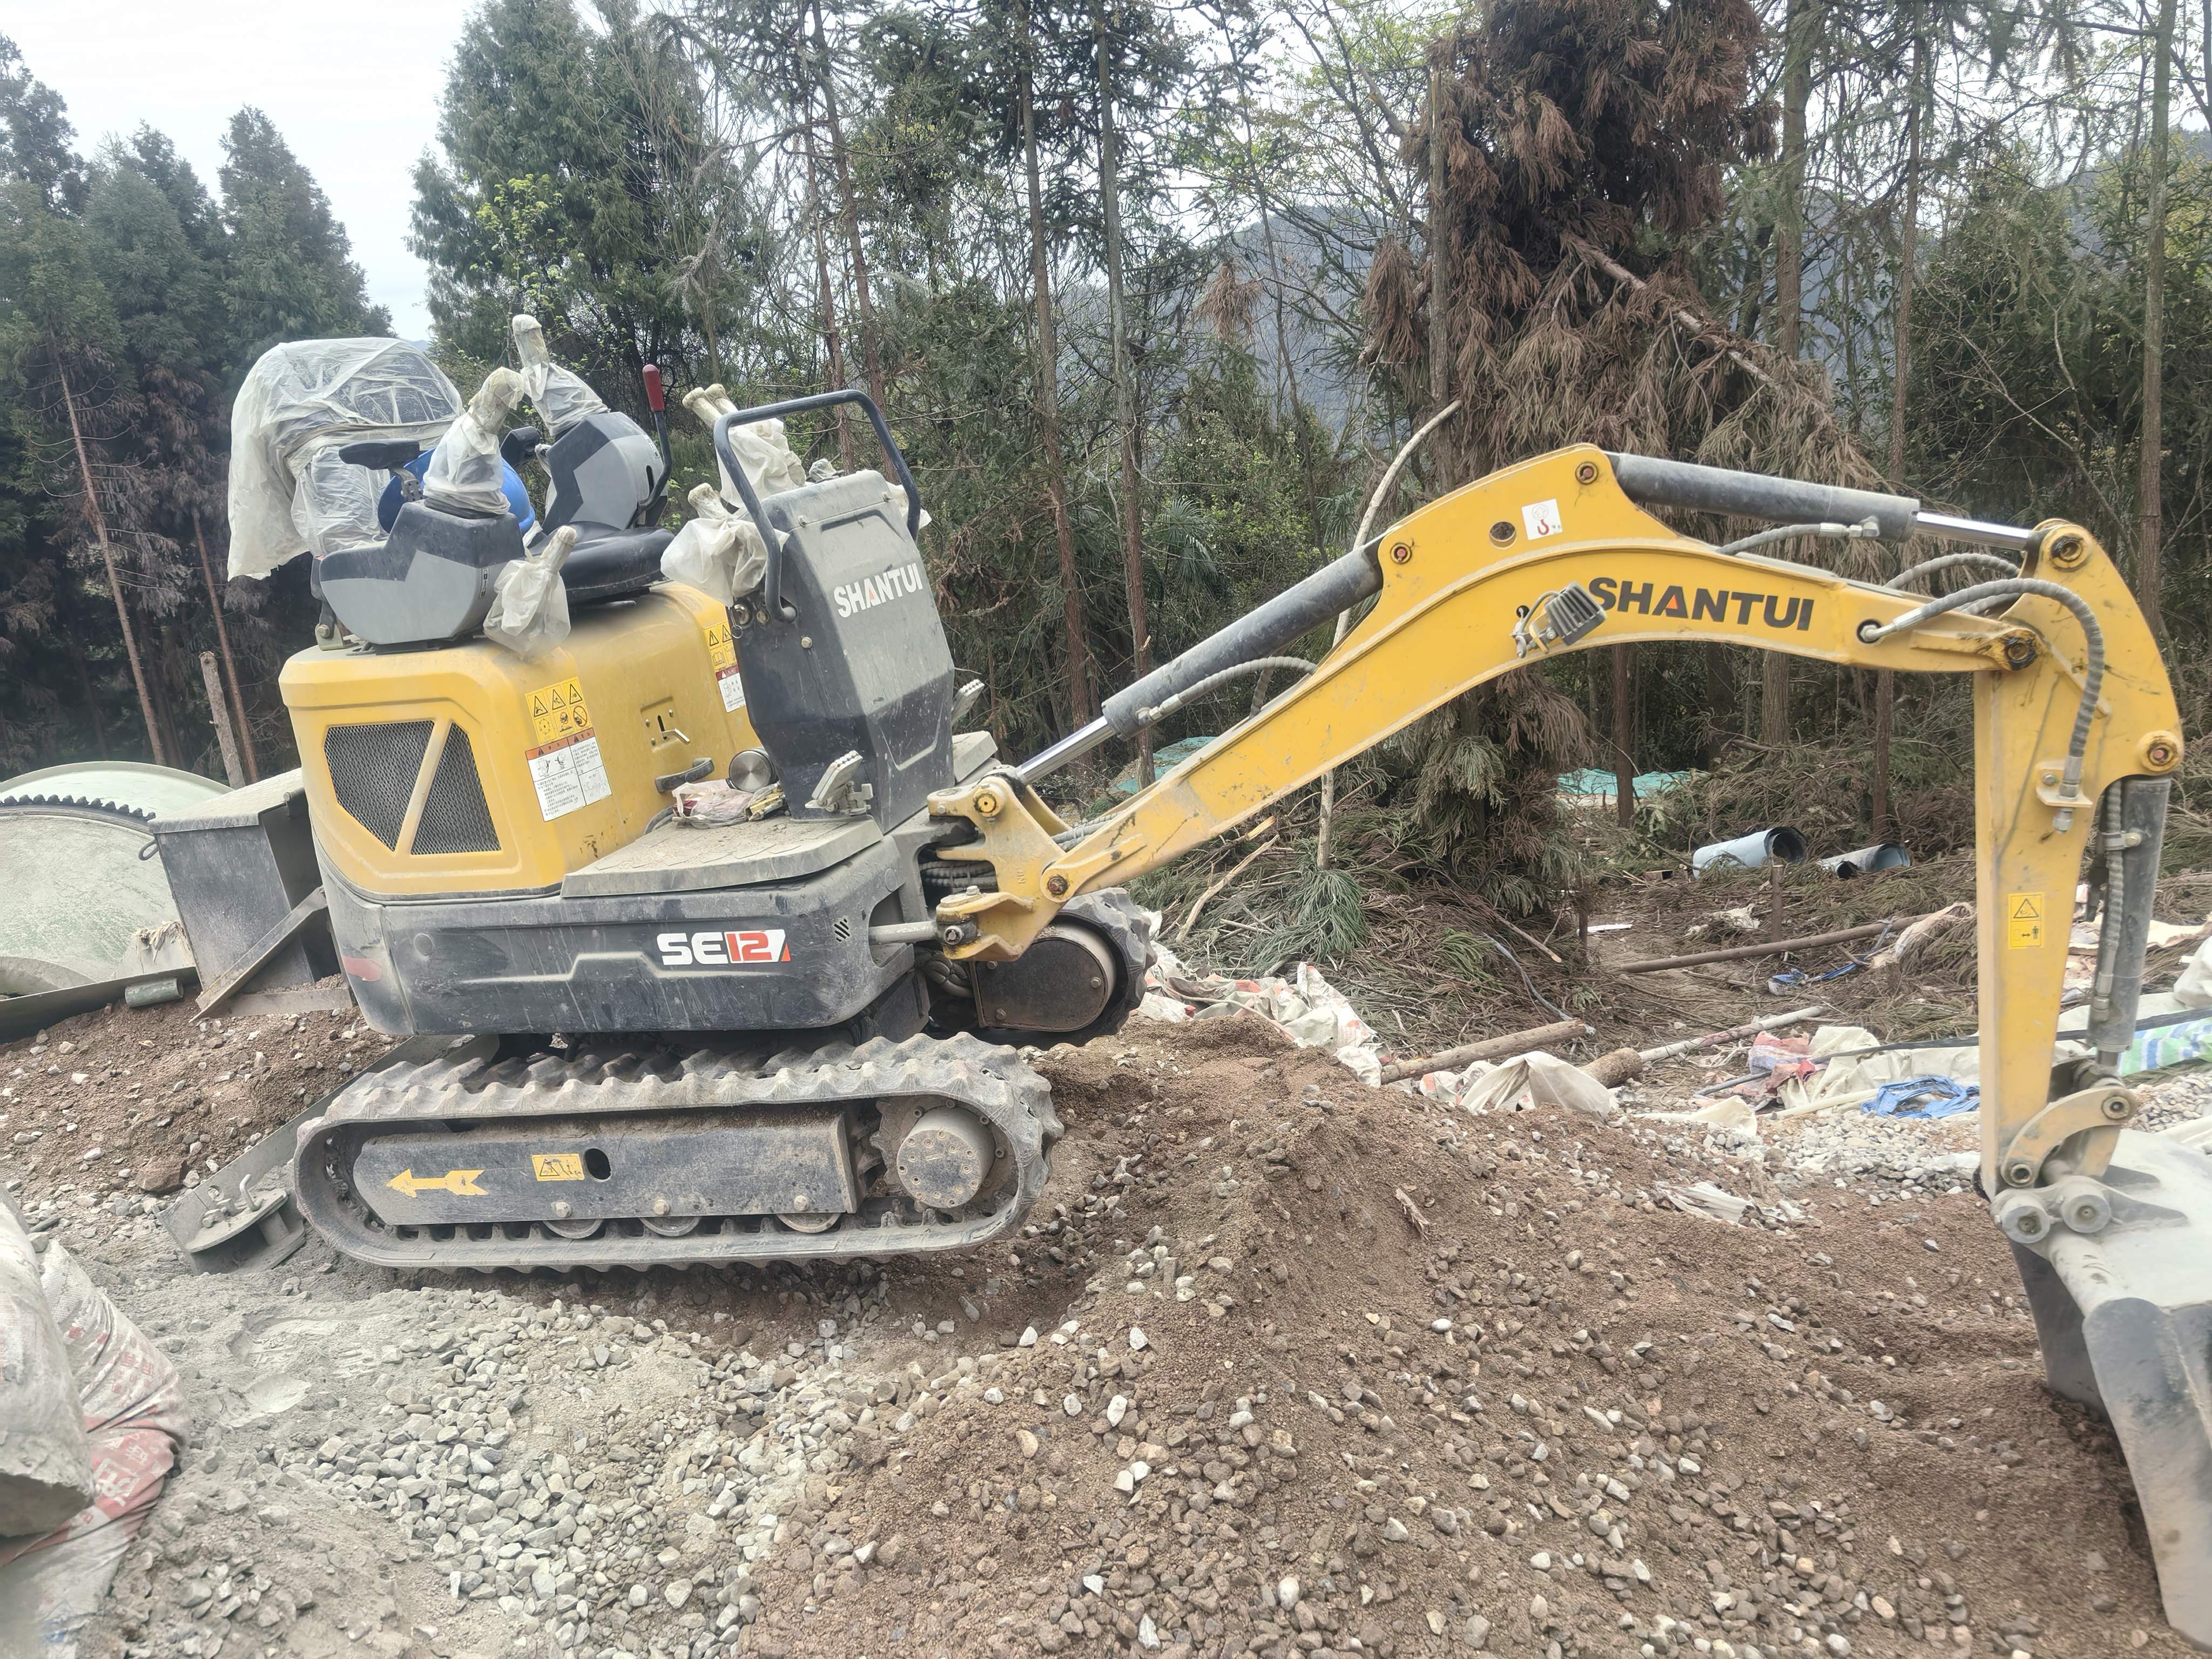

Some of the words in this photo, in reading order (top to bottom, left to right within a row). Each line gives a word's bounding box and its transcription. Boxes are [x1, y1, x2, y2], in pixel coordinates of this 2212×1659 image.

[833, 563, 923, 618] SHANTUI
[1588, 577, 1815, 631] SHANTUI
[657, 932, 773, 965] SE12
